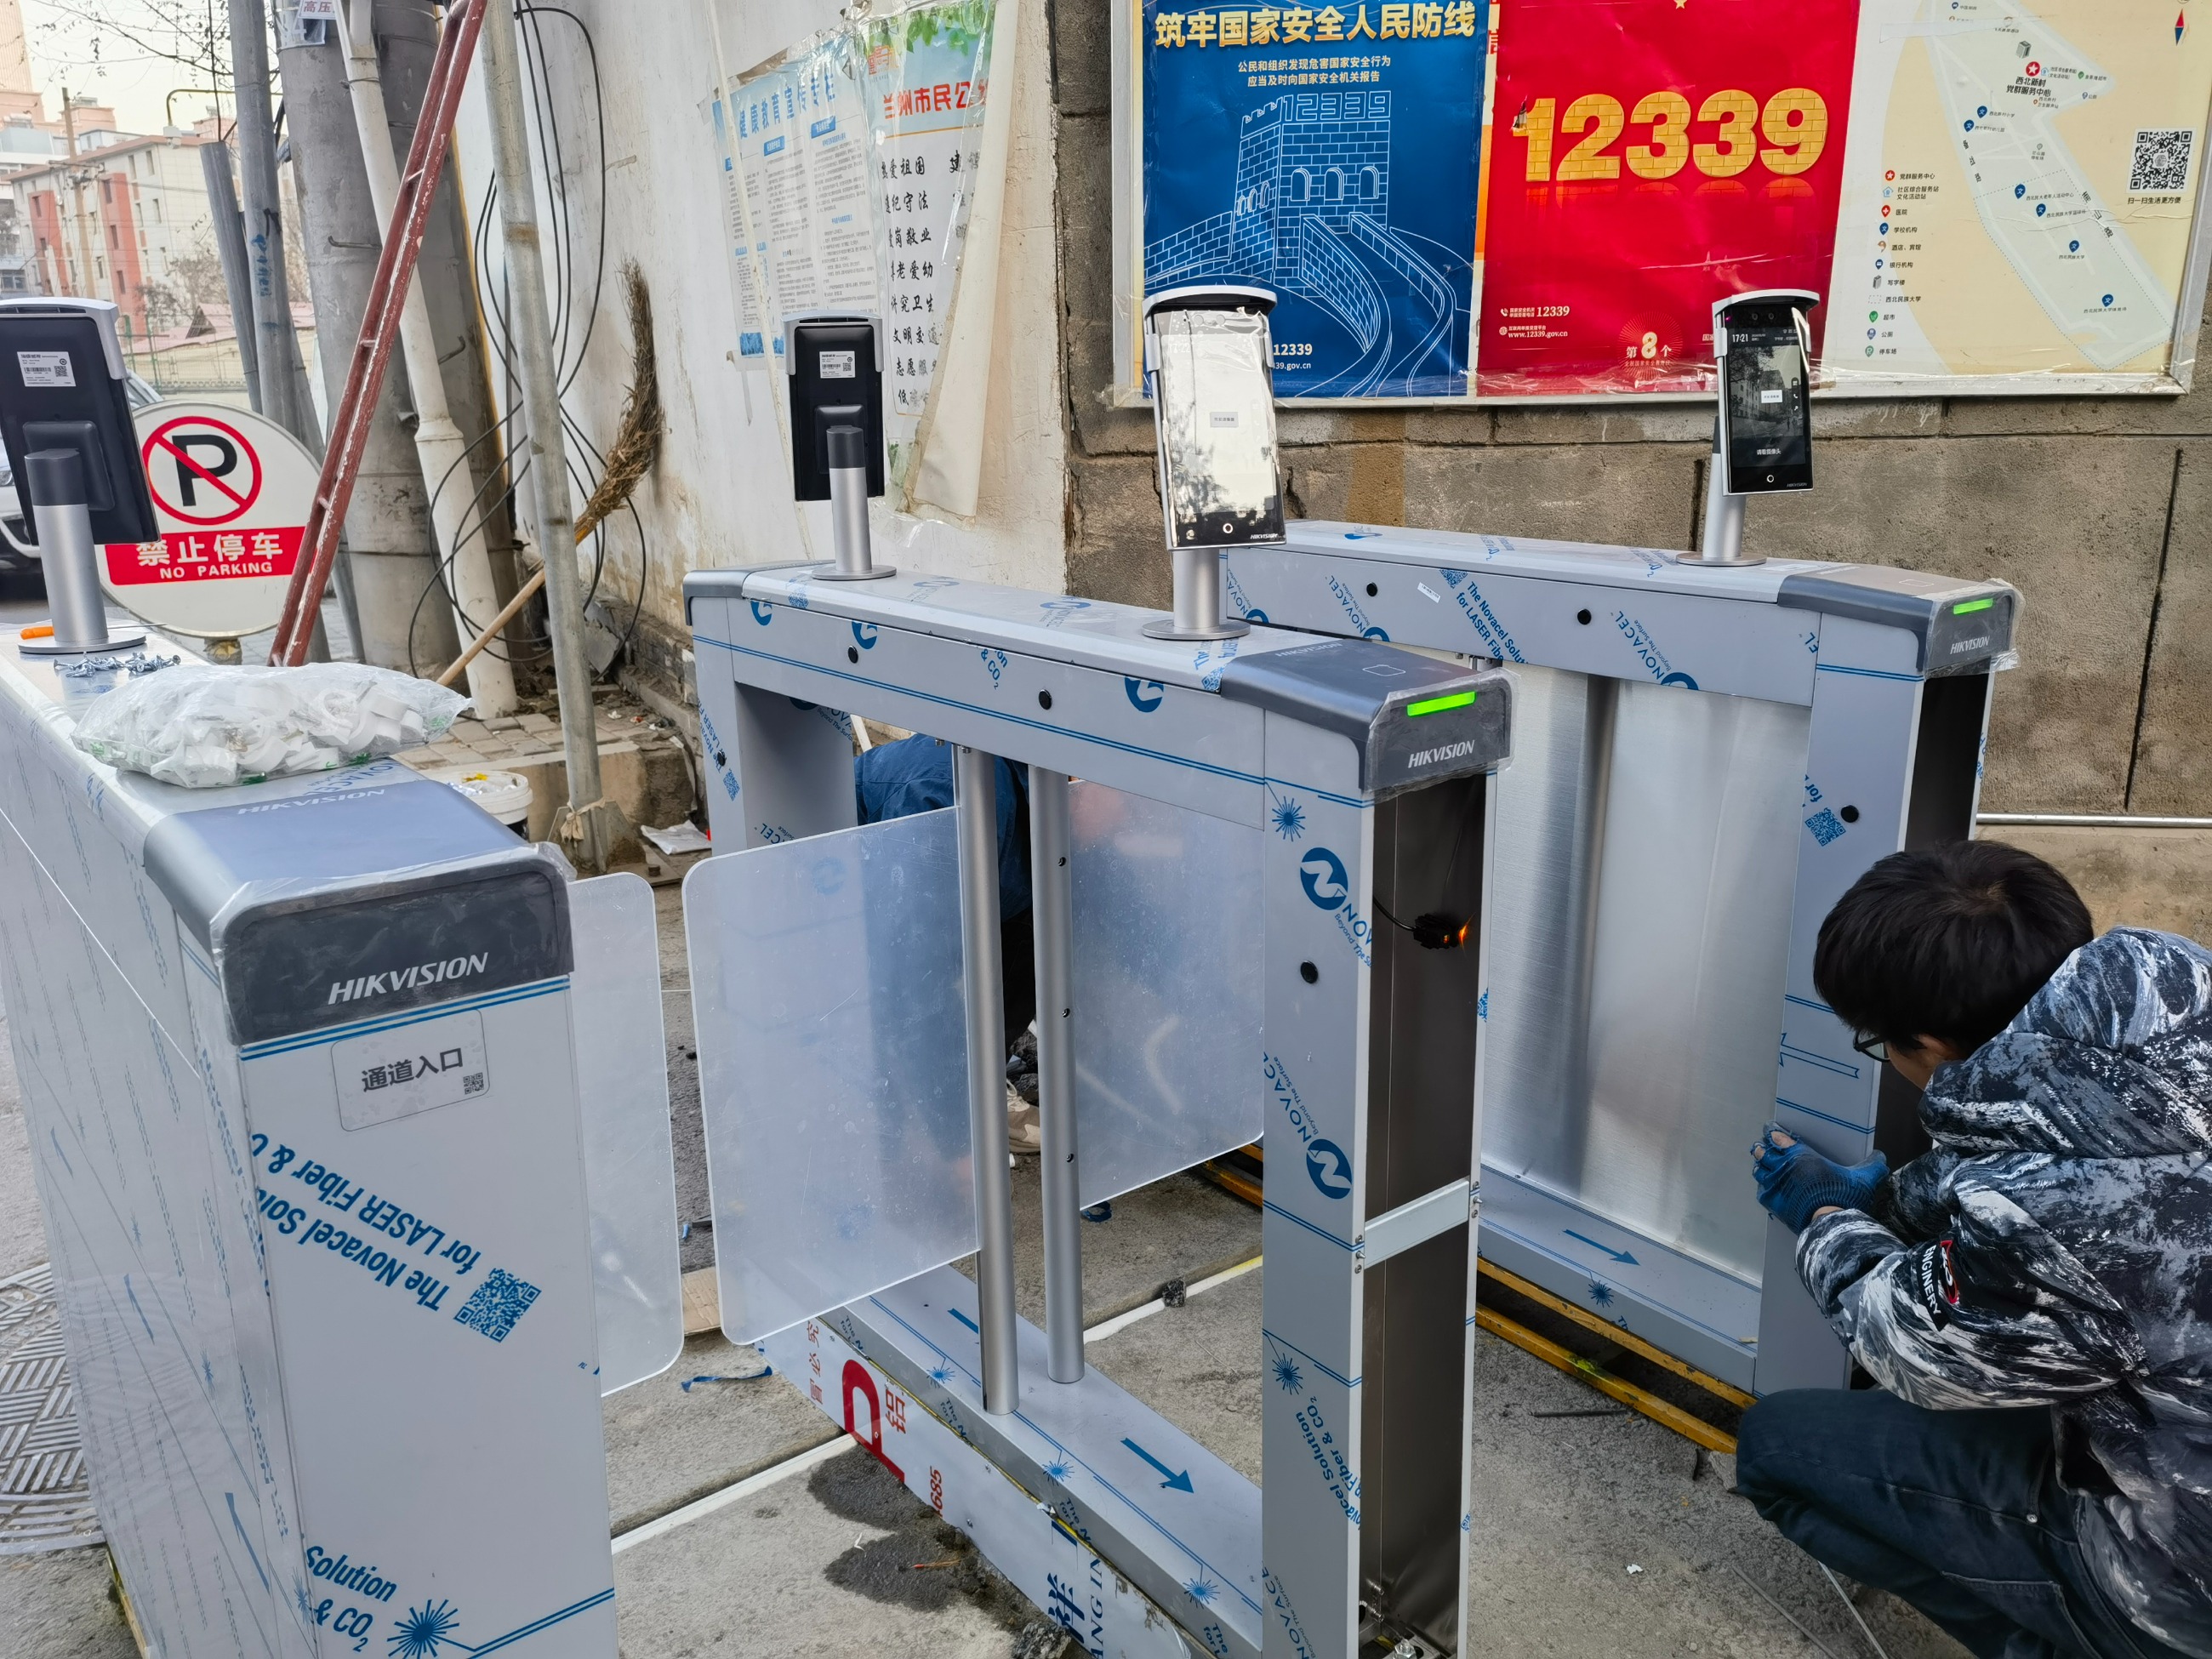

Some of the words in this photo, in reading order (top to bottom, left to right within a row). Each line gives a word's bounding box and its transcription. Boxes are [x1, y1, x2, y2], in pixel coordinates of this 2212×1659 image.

[1154, 1, 1476, 48] 筑牢国家安全人民防线
[1238, 55, 1391, 72] 公民和组织发现危害国家安全行为
[1247, 71, 1380, 88] 应当及时向国家安全机关报告
[2006, 84, 2051, 97] 党群服务中心
[2015, 77, 2046, 87] 西北新村
[1282, 90, 1392, 122] 12339
[1514, 88, 1827, 181] 12339
[1536, 305, 1570, 317] 12339
[1273, 343, 1313, 356] 12339
[1732, 334, 1748, 343] 17:21
[1273, 362, 1311, 371] 39.gov.cn
[137, 533, 284, 567] 禁止停车
[160, 565, 185, 579] NO
[198, 560, 273, 578] PARKING
[1330, 575, 1366, 634] NOVACEL
[1467, 581, 1480, 601] The
[1479, 599, 1509, 641] Novacel
[1456, 592, 1468, 609] for
[1465, 606, 1491, 641] LASER
[1487, 639, 1505, 661] Fibe
[1633, 619, 1650, 641] Surface
[1615, 611, 1665, 680] NOVACEL
[1950, 636, 1990, 655] HIKVISION
[1408, 739, 1475, 769] HIKVISION
[237, 789, 385, 815] HIKVISION
[1804, 784, 1823, 802] for
[1335, 913, 1354, 945] Beyond
[328, 951, 489, 1006] HIKVISION
[361, 1047, 464, 1093] 通道入口
[291, 1160, 365, 1211] Fiber
[357, 1194, 446, 1257] LASER
[299, 1218, 408, 1287] Novacel
[440, 1240, 482, 1274] for
[405, 1270, 450, 1311] The
[1922, 1245, 1941, 1314] ENGINERY
[1296, 1411, 1334, 1480] Solution
[1212, 1622, 1228, 1653] The
